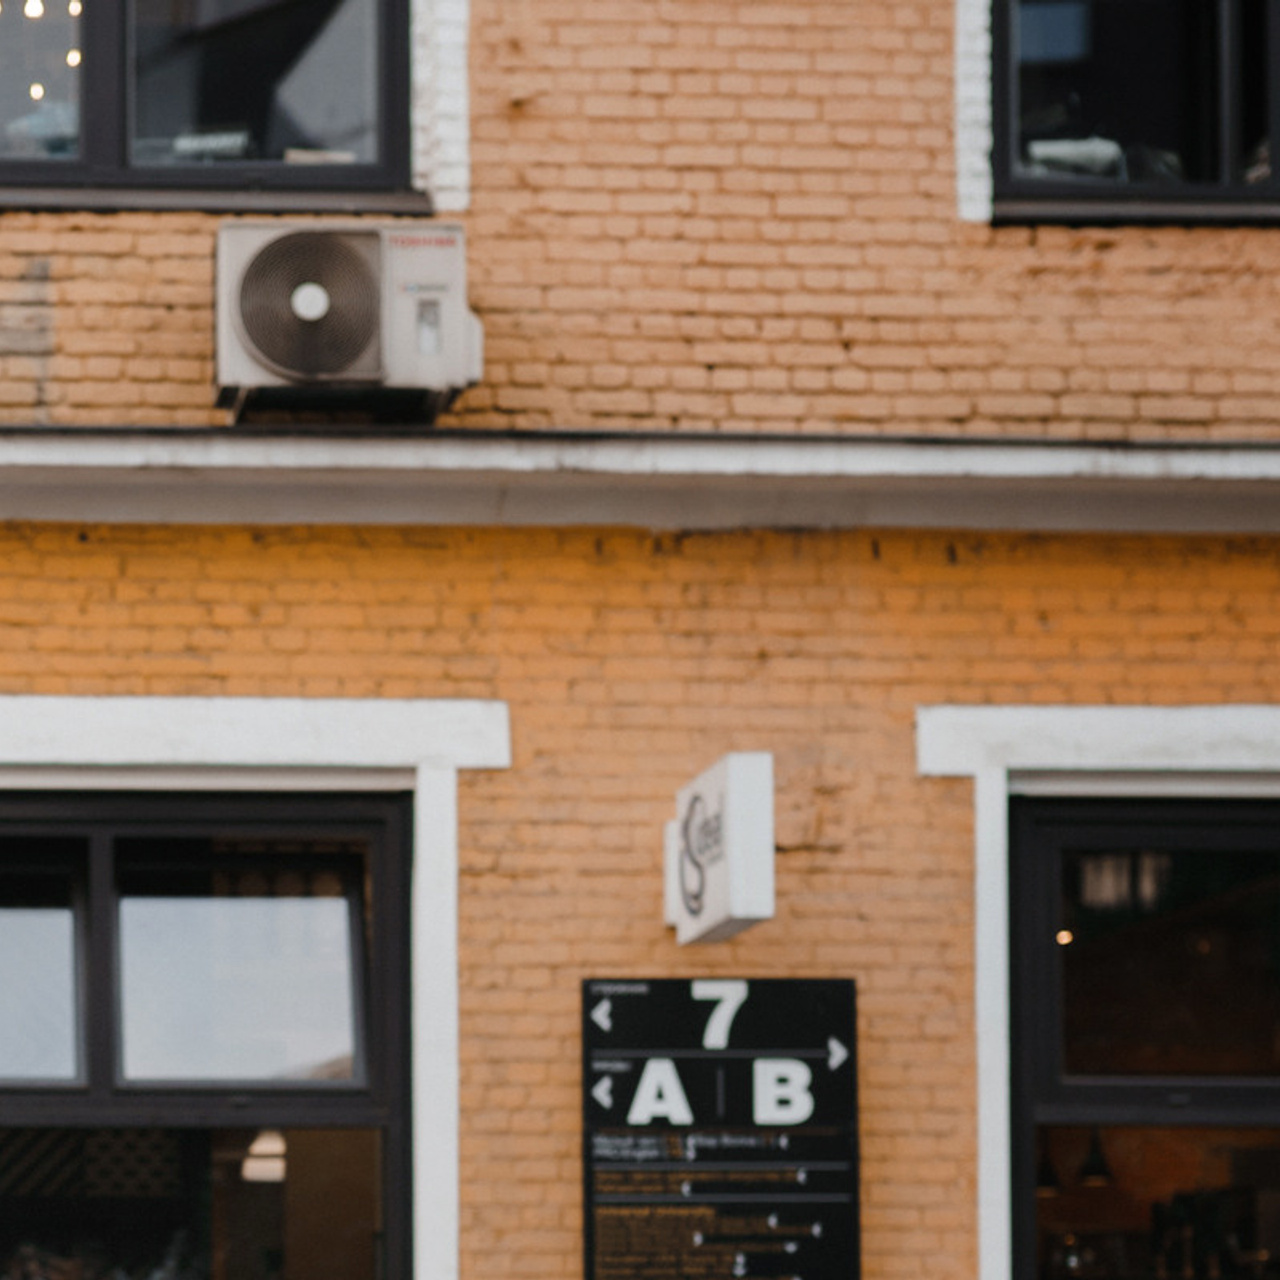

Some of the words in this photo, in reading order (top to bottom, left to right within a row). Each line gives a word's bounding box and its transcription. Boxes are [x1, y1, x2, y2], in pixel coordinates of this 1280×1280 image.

[691, 979, 748, 1049] 7
[626, 1058, 694, 1125] A
[753, 1058, 815, 1125] B
